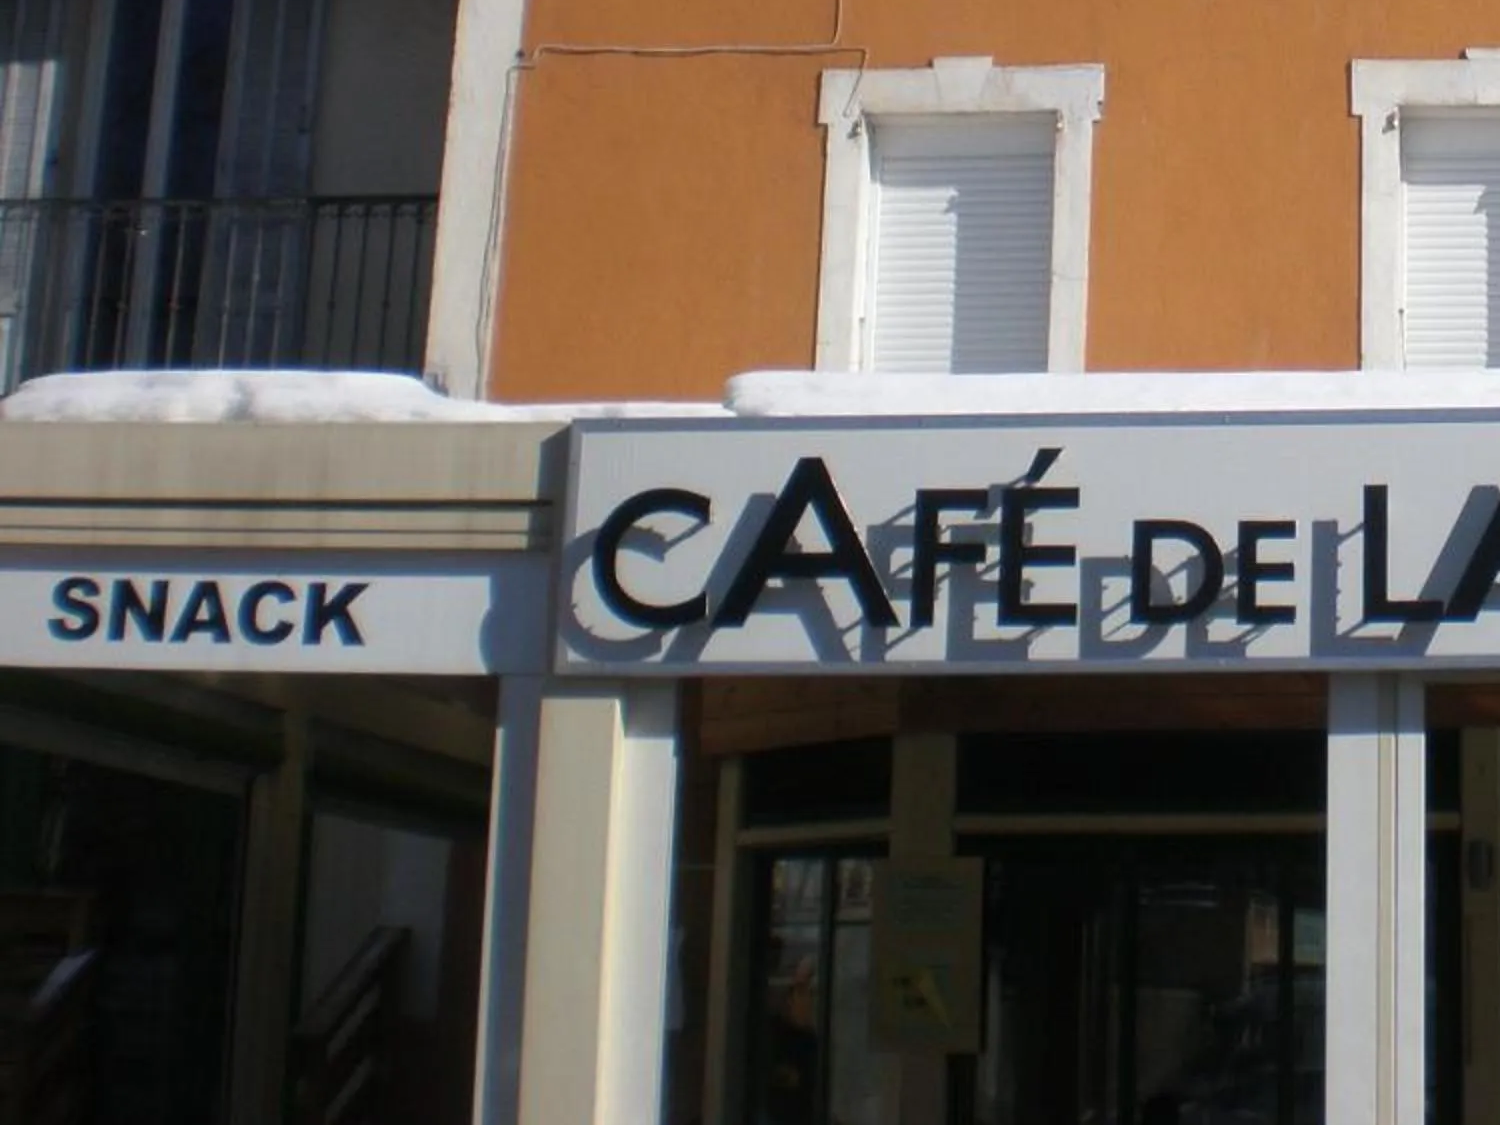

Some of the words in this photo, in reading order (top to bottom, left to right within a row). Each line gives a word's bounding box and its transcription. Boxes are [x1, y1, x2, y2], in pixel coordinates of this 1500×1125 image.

[593, 447, 1080, 628] CAFÉ
[1130, 518, 1297, 626] DE
[47, 577, 371, 647] SNACK
